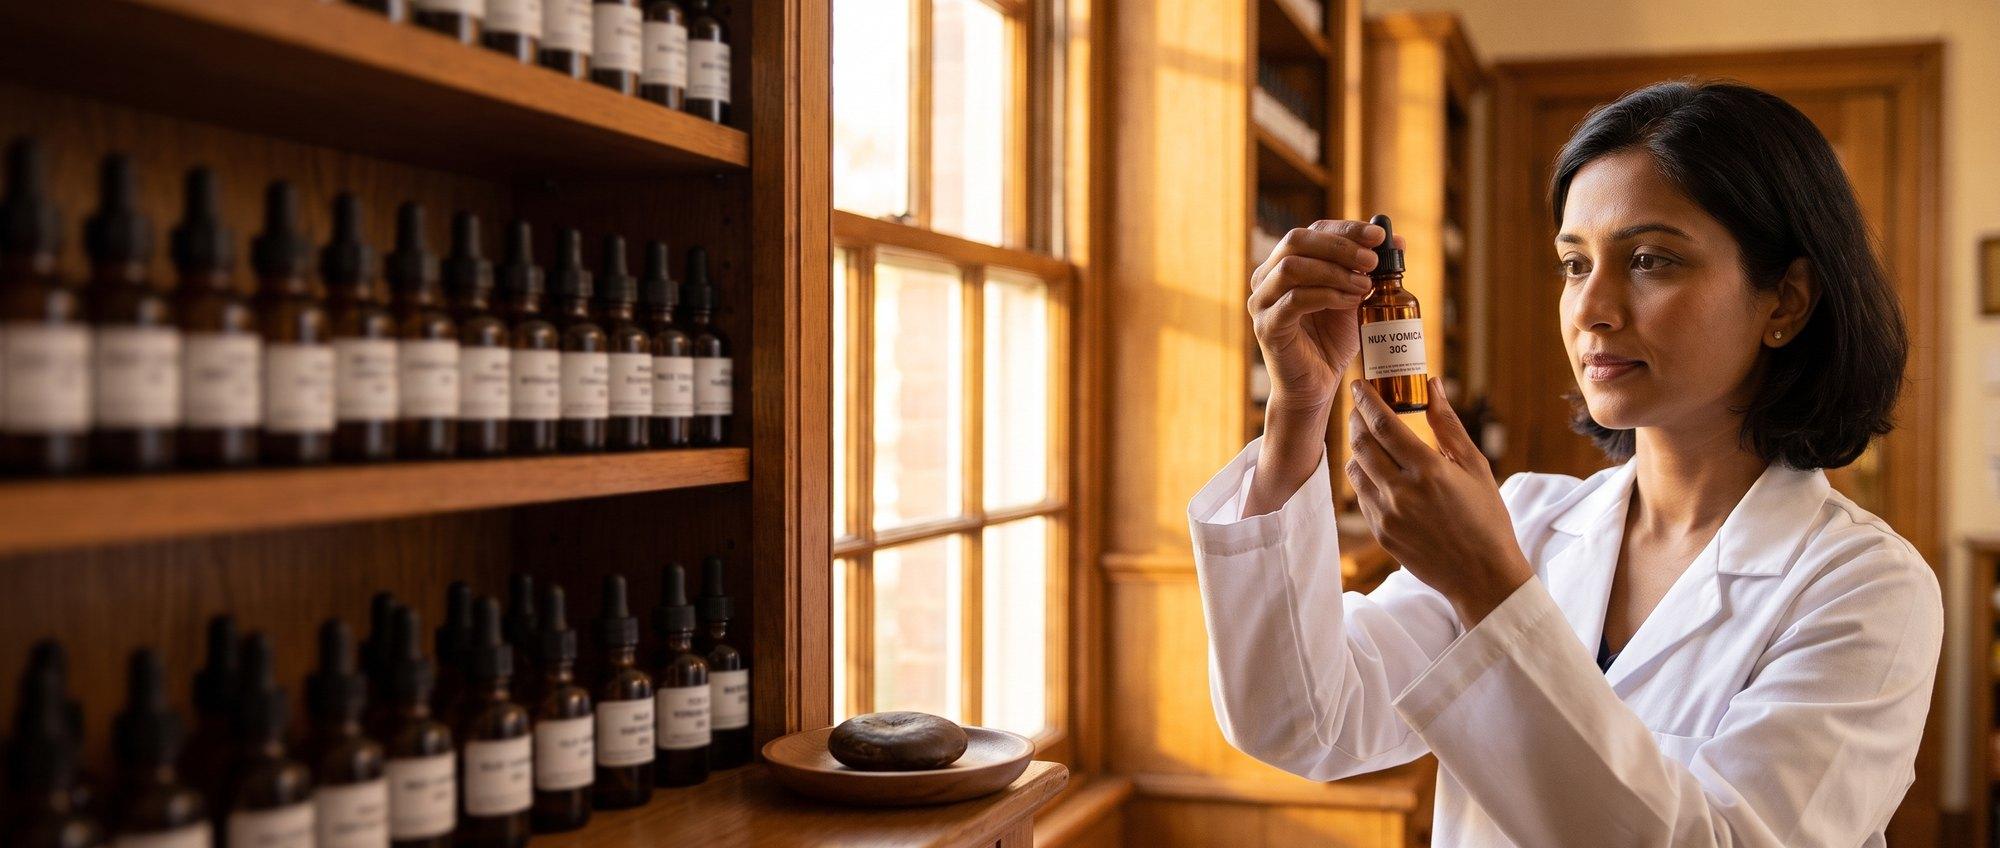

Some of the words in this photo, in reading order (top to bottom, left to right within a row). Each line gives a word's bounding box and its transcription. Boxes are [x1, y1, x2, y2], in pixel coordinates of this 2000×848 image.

[1368, 334, 1387, 344] NUX
[1389, 331, 1422, 342] VOMICA
[1389, 344, 1408, 354] 30C
